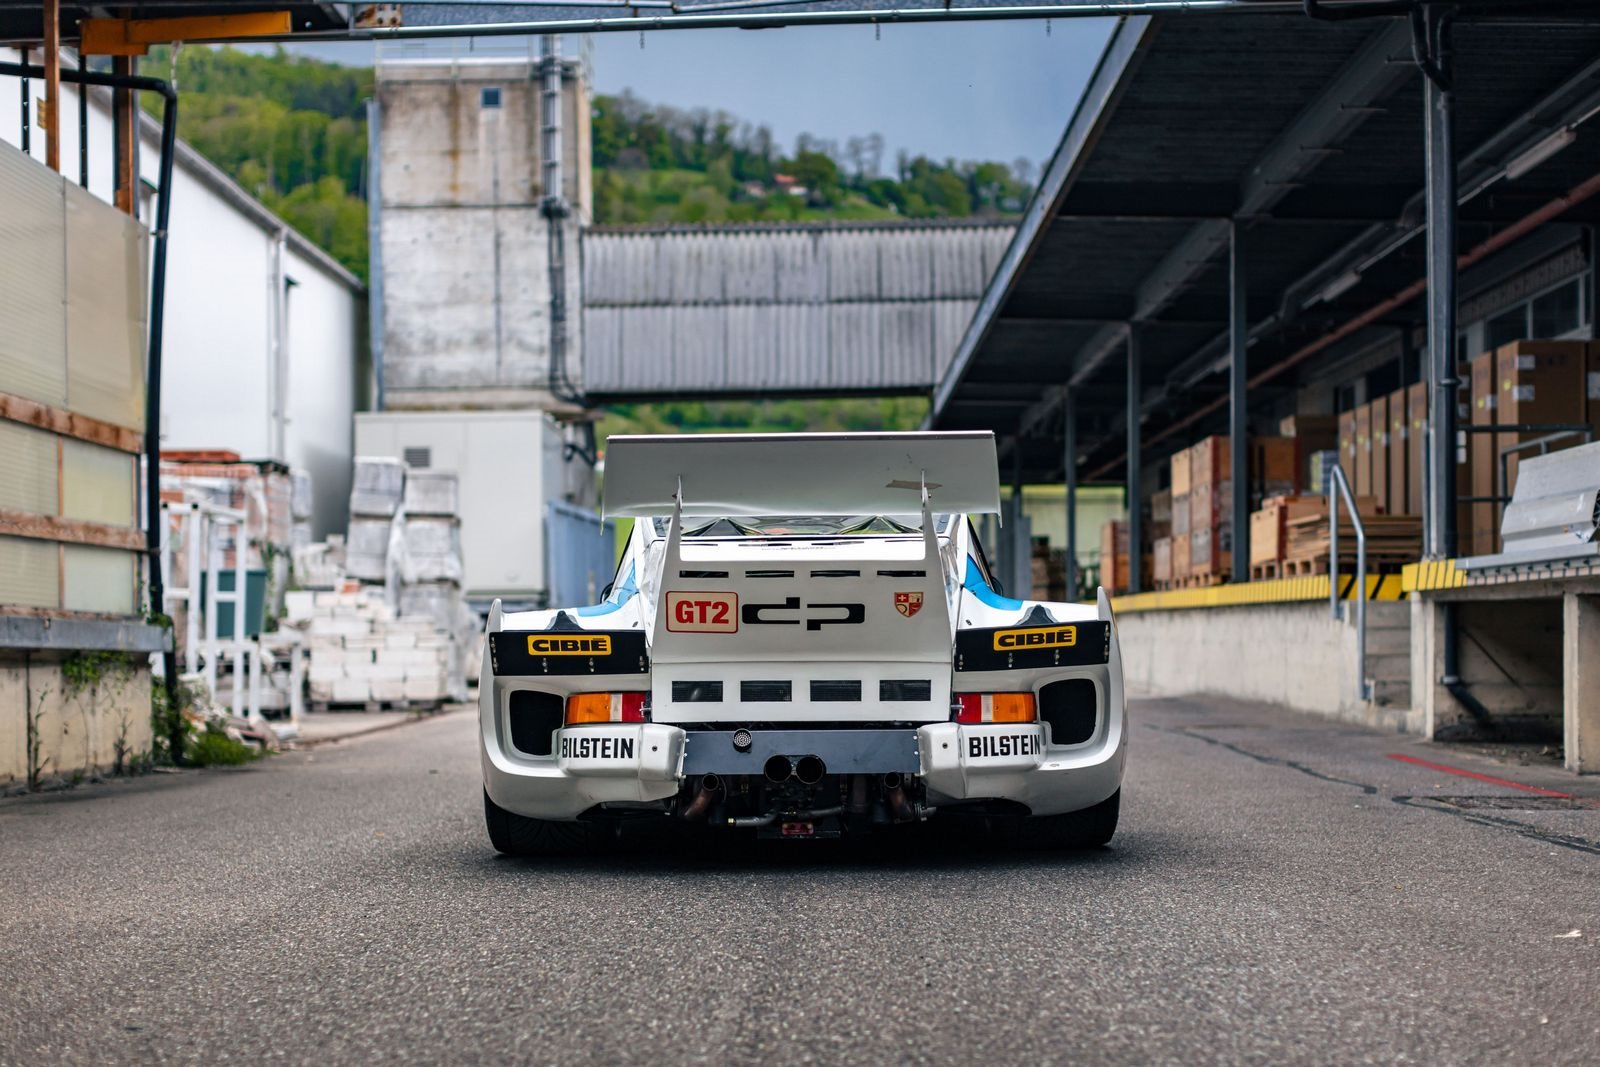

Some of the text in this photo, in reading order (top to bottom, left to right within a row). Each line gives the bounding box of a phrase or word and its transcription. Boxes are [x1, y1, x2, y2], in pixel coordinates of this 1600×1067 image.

[675, 600, 729, 624] GT2
[562, 737, 634, 759] BILSTEIN
[968, 734, 1041, 758] BILSTEIN
